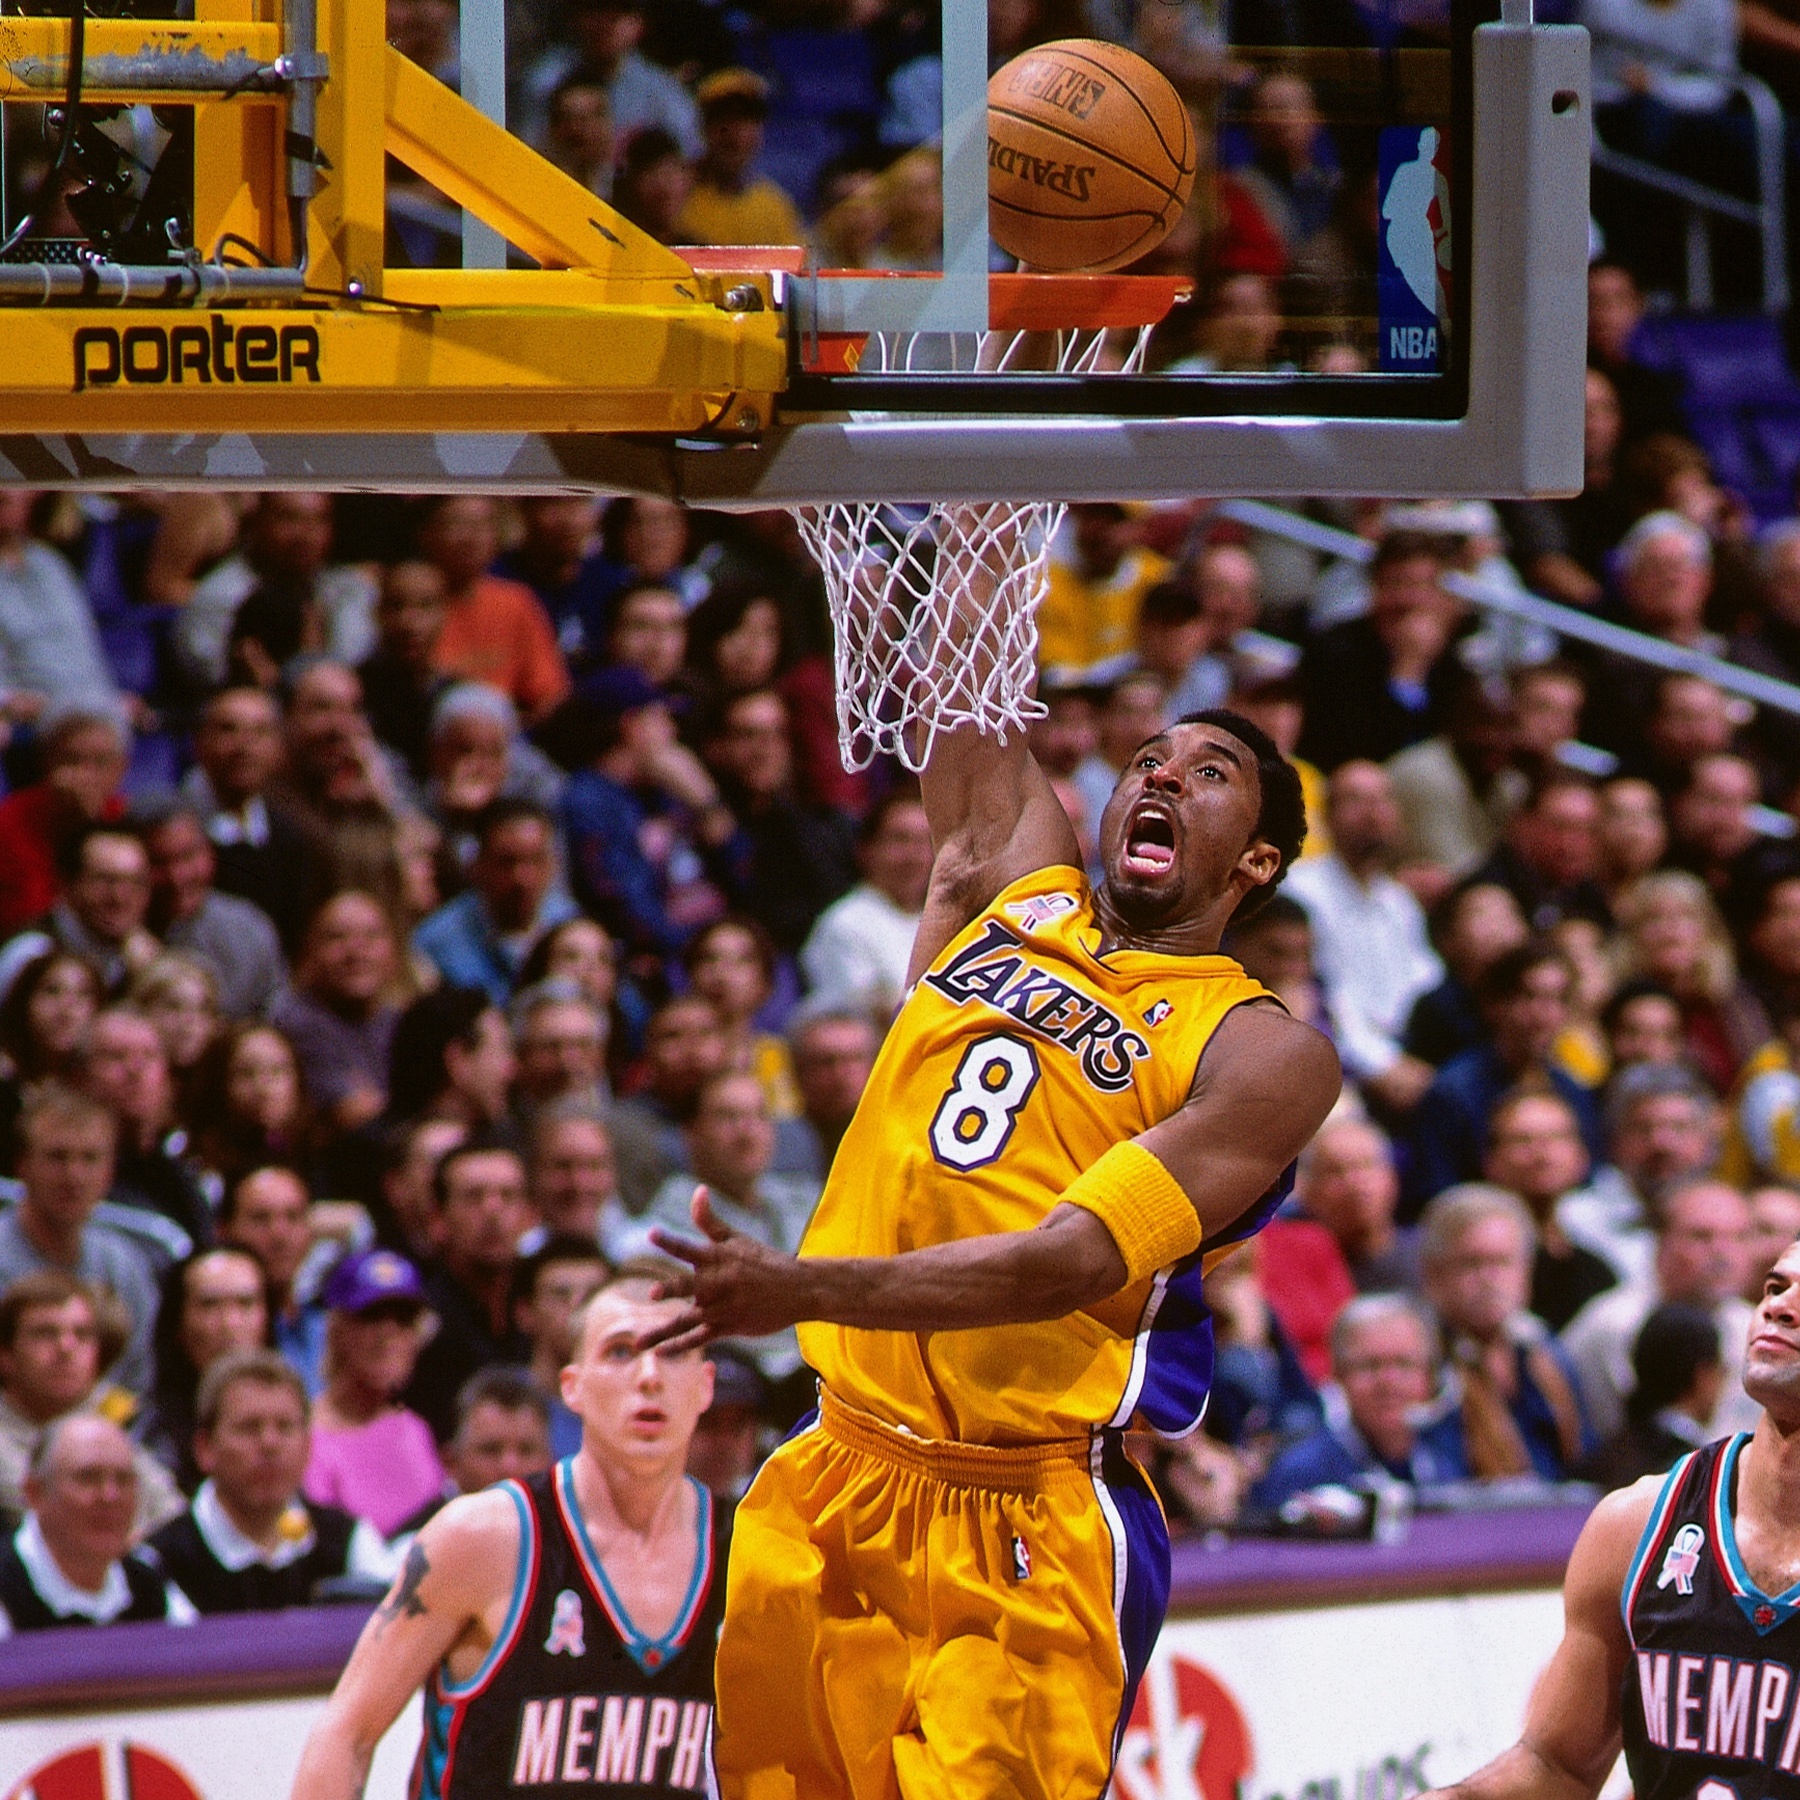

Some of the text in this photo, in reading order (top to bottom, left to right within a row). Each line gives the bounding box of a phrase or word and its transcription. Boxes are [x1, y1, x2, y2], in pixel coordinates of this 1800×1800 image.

[1390, 326, 1437, 359] NBA
[922, 919, 1151, 1094] LAKERS
[928, 1031, 1042, 1173] 8
[512, 1694, 709, 1791] MEMPH
